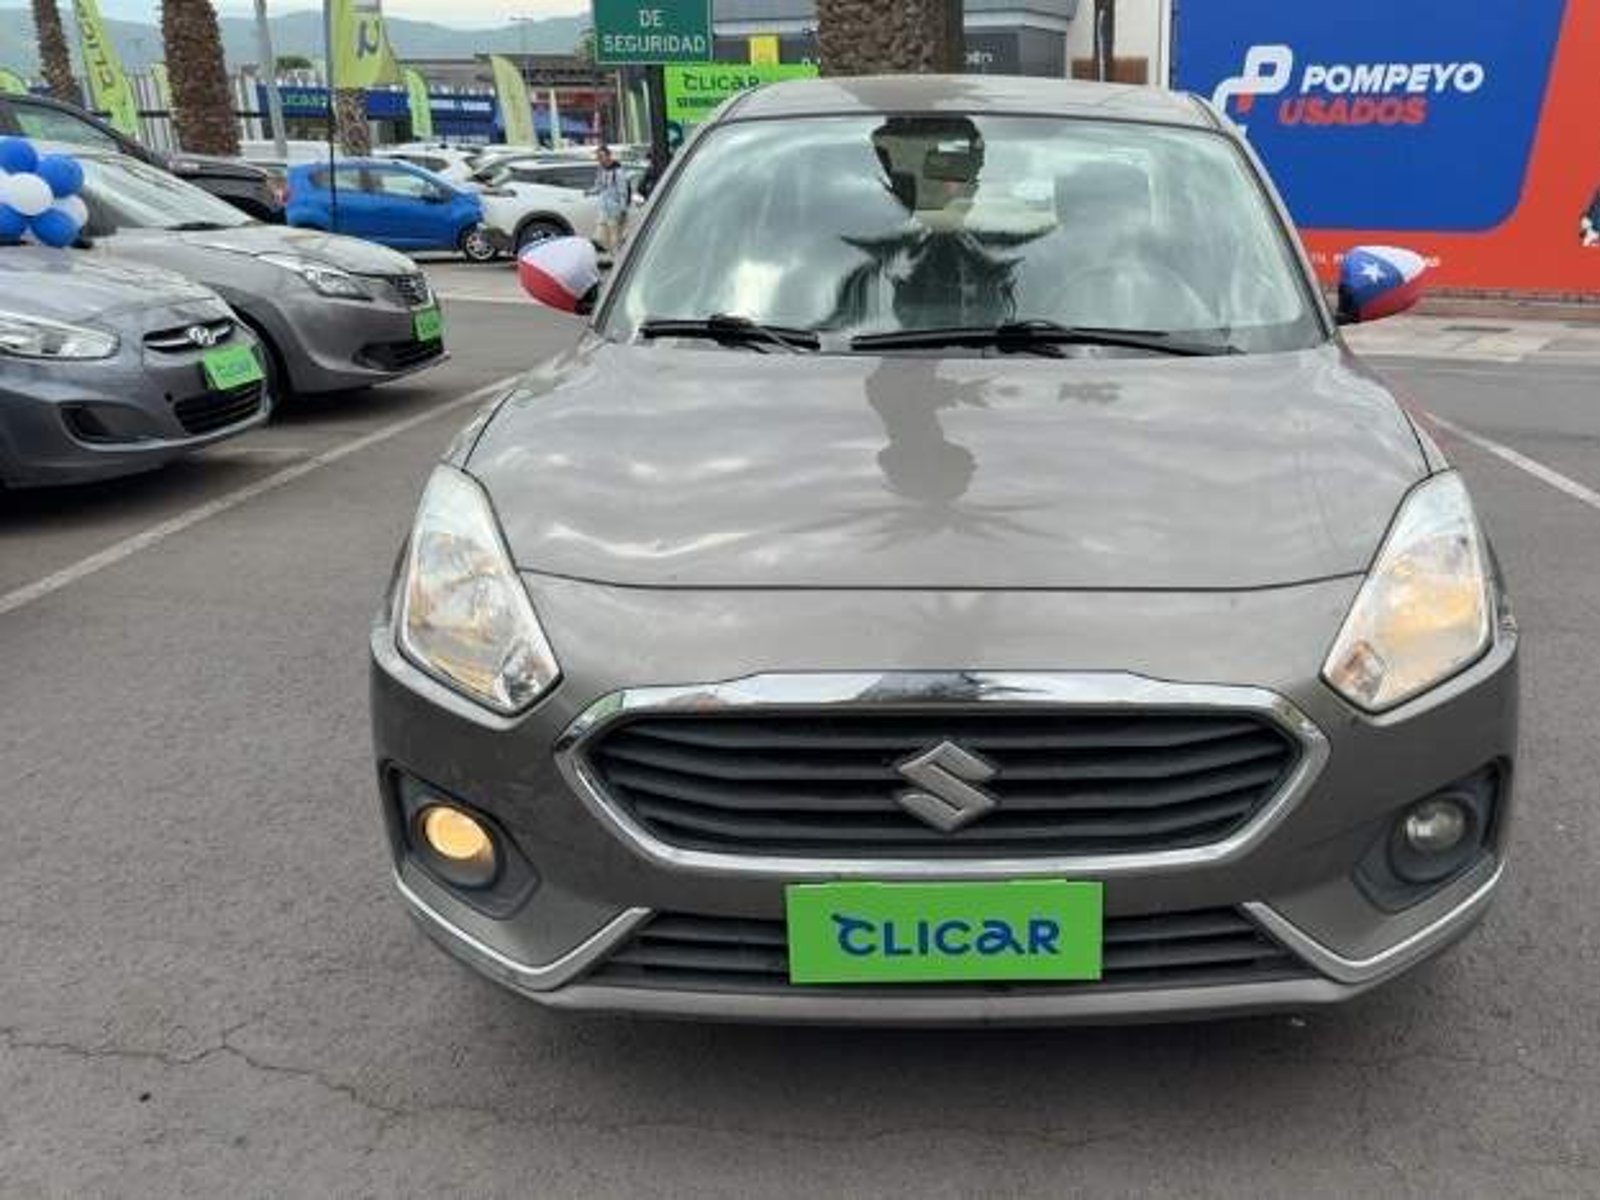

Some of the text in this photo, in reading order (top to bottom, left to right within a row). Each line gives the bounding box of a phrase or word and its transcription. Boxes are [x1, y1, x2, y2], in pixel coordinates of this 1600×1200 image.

[638, 9, 664, 28] DE
[603, 34, 706, 54] SEGURIDAD
[1301, 62, 1485, 94] POMPEYO
[1279, 97, 1428, 125] USADOS
